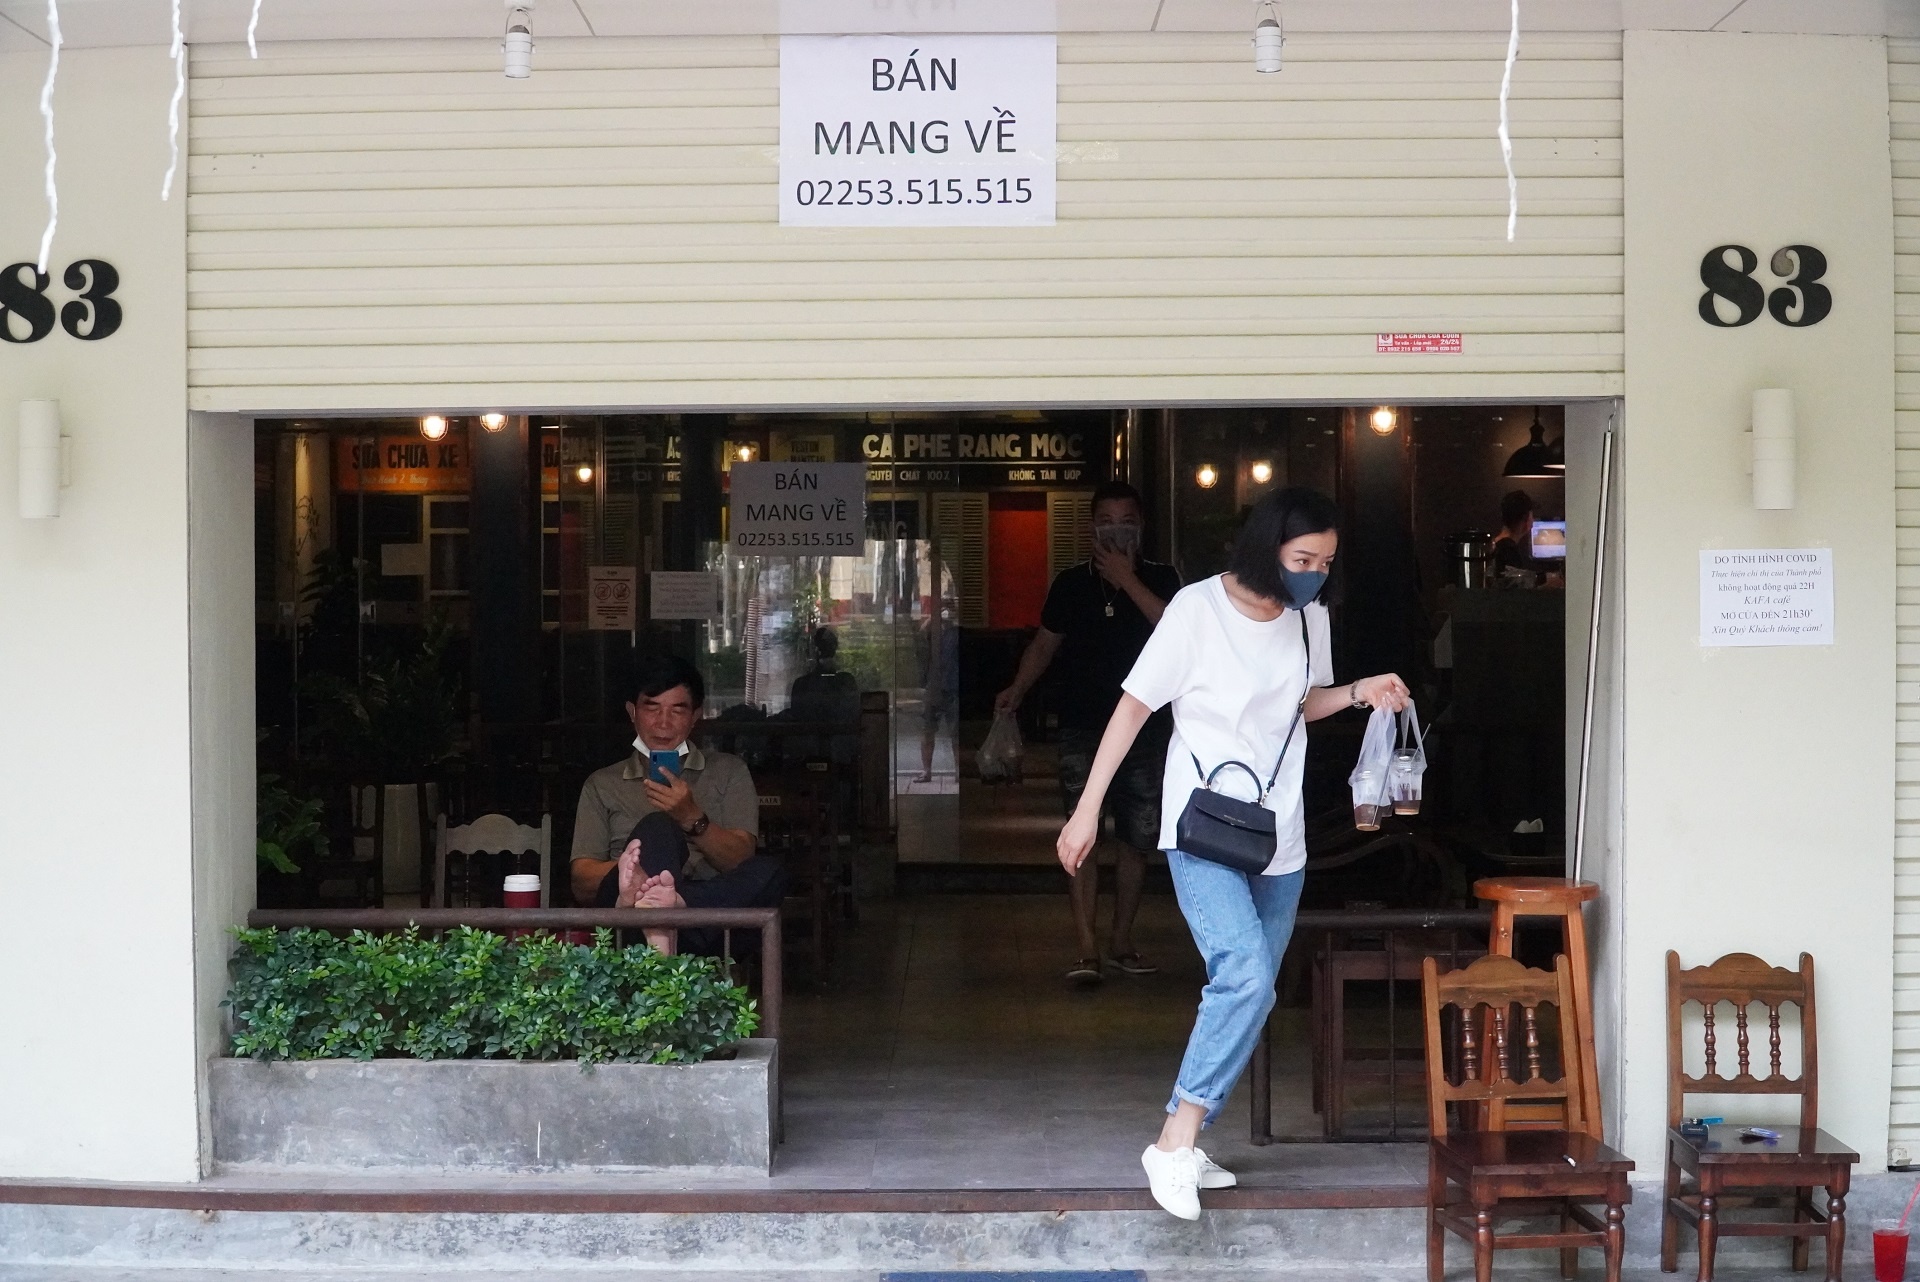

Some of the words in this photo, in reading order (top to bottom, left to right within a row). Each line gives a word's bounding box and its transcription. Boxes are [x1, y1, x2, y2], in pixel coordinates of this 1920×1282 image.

[872, 48, 957, 92] BÁN
[814, 119, 949, 155] MANG
[964, 106, 1017, 154] VỀ
[796, 177, 1033, 206] 02253.515.515
[1698, 244, 1832, 328] 83
[0, 259, 123, 344] 83
[958, 433, 1022, 458] RANG
[775, 468, 818, 490] BÁN
[746, 504, 813, 521] MANG
[821, 497, 847, 521] VỀ
[738, 532, 855, 546] 02253.515.515
[1714, 556, 1729, 564] DO
[1732, 554, 1755, 564] TÌNH
[1758, 553, 1783, 563] HÌNH
[1785, 554, 1817, 563] COVID
[1718, 583, 1742, 592] không
[1744, 583, 1761, 591] hoạt
[1762, 583, 1782, 592] động
[1799, 582, 1815, 590] 22H
[1743, 596, 1770, 605] KAFA
[1711, 626, 1727, 634] Xin
[1748, 625, 1775, 633] Khách
[1777, 624, 1800, 634] thông
